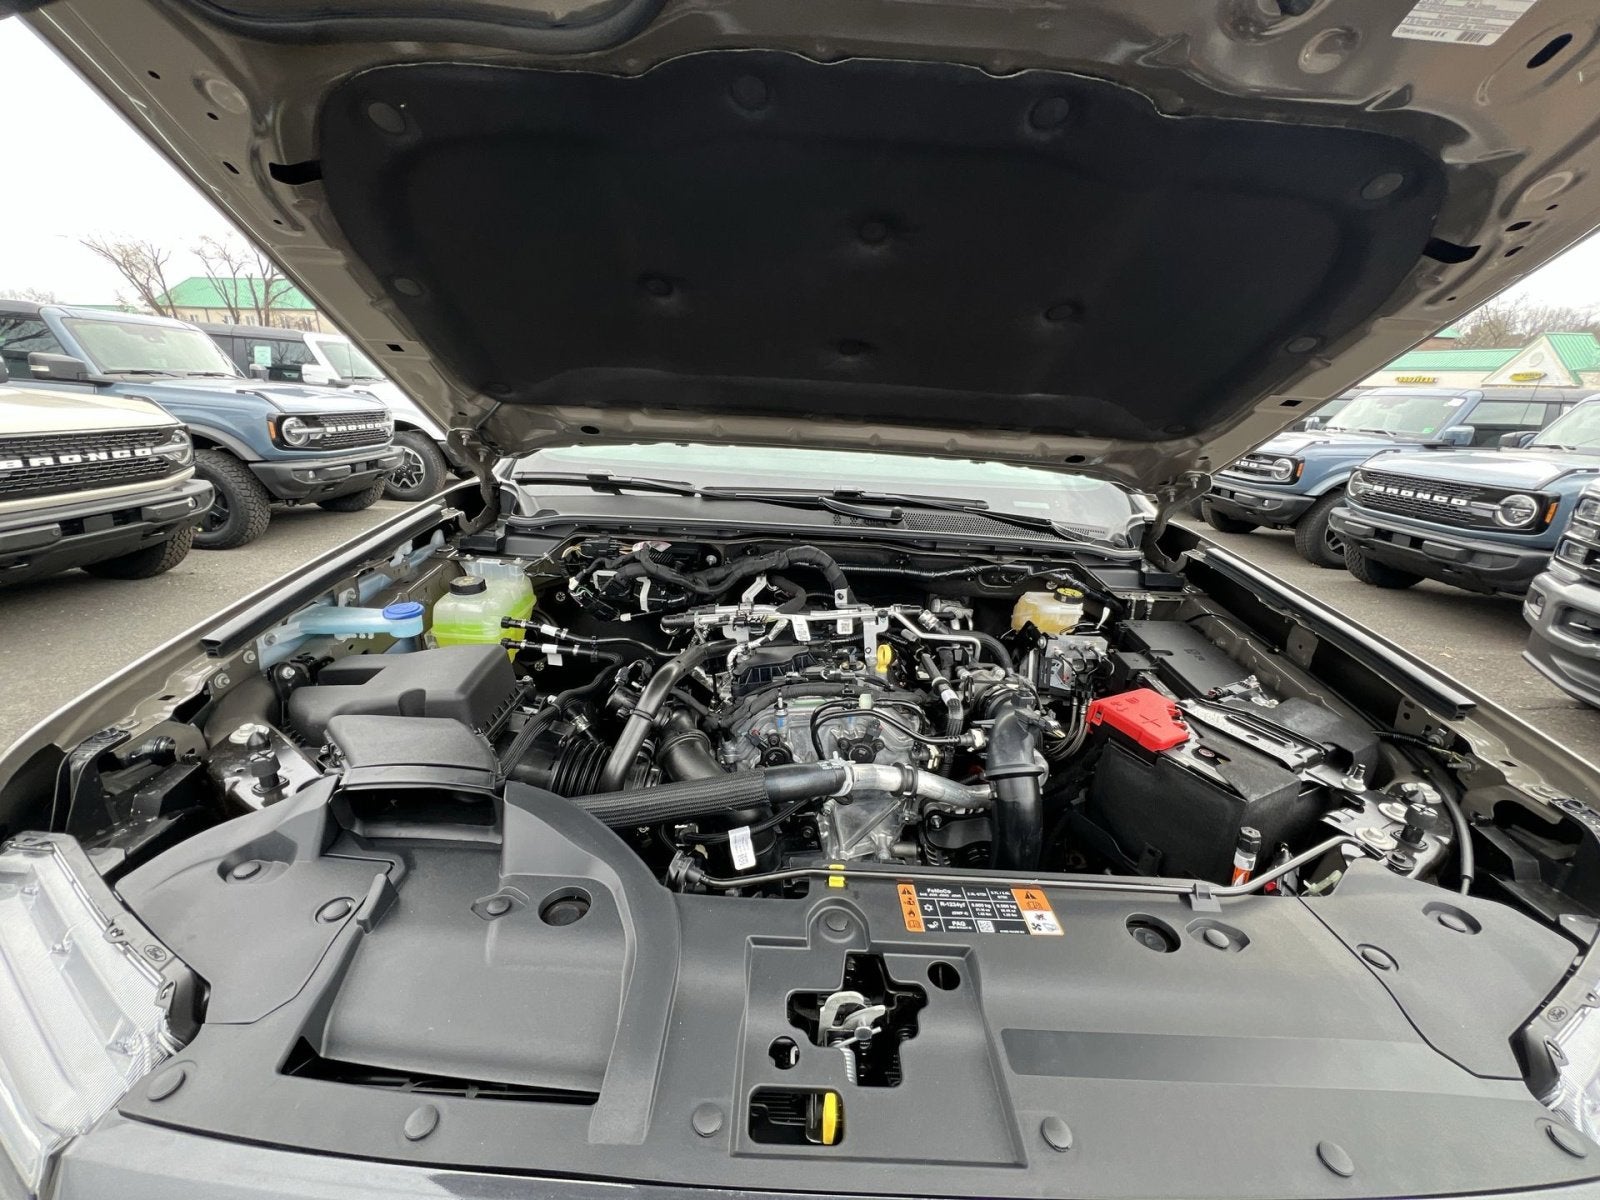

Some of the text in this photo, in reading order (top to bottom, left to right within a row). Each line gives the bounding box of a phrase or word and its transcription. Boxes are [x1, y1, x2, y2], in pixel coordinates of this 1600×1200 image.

[326, 423, 381, 432] BRONCO
[0, 449, 152, 470] BRONCO
[1373, 485, 1467, 506] BRONCO
